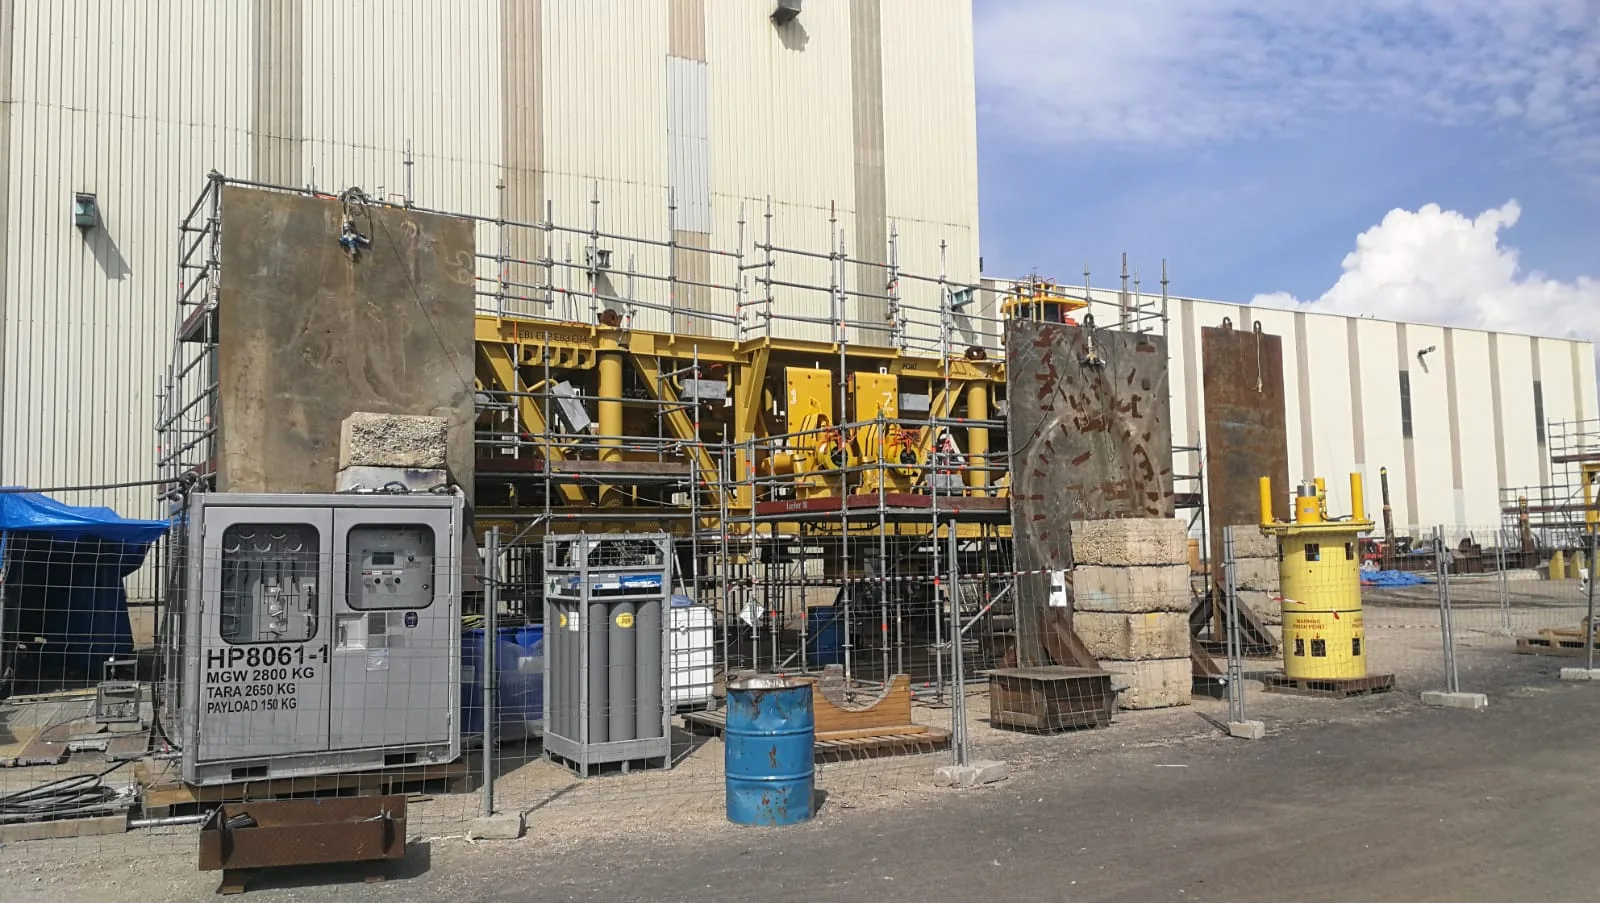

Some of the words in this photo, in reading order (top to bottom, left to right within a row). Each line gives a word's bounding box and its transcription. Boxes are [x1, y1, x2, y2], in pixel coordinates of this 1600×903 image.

[207, 644, 328, 669] HP8061-1
[206, 669, 248, 684] MGW
[252, 668, 287, 681] 2800
[292, 667, 315, 679] KG
[206, 685, 242, 698] TARA
[245, 684, 273, 696] 2650
[277, 683, 296, 695] KG
[207, 700, 258, 714] PAYLOAD
[261, 698, 279, 710] 150
[281, 697, 297, 710] KG
